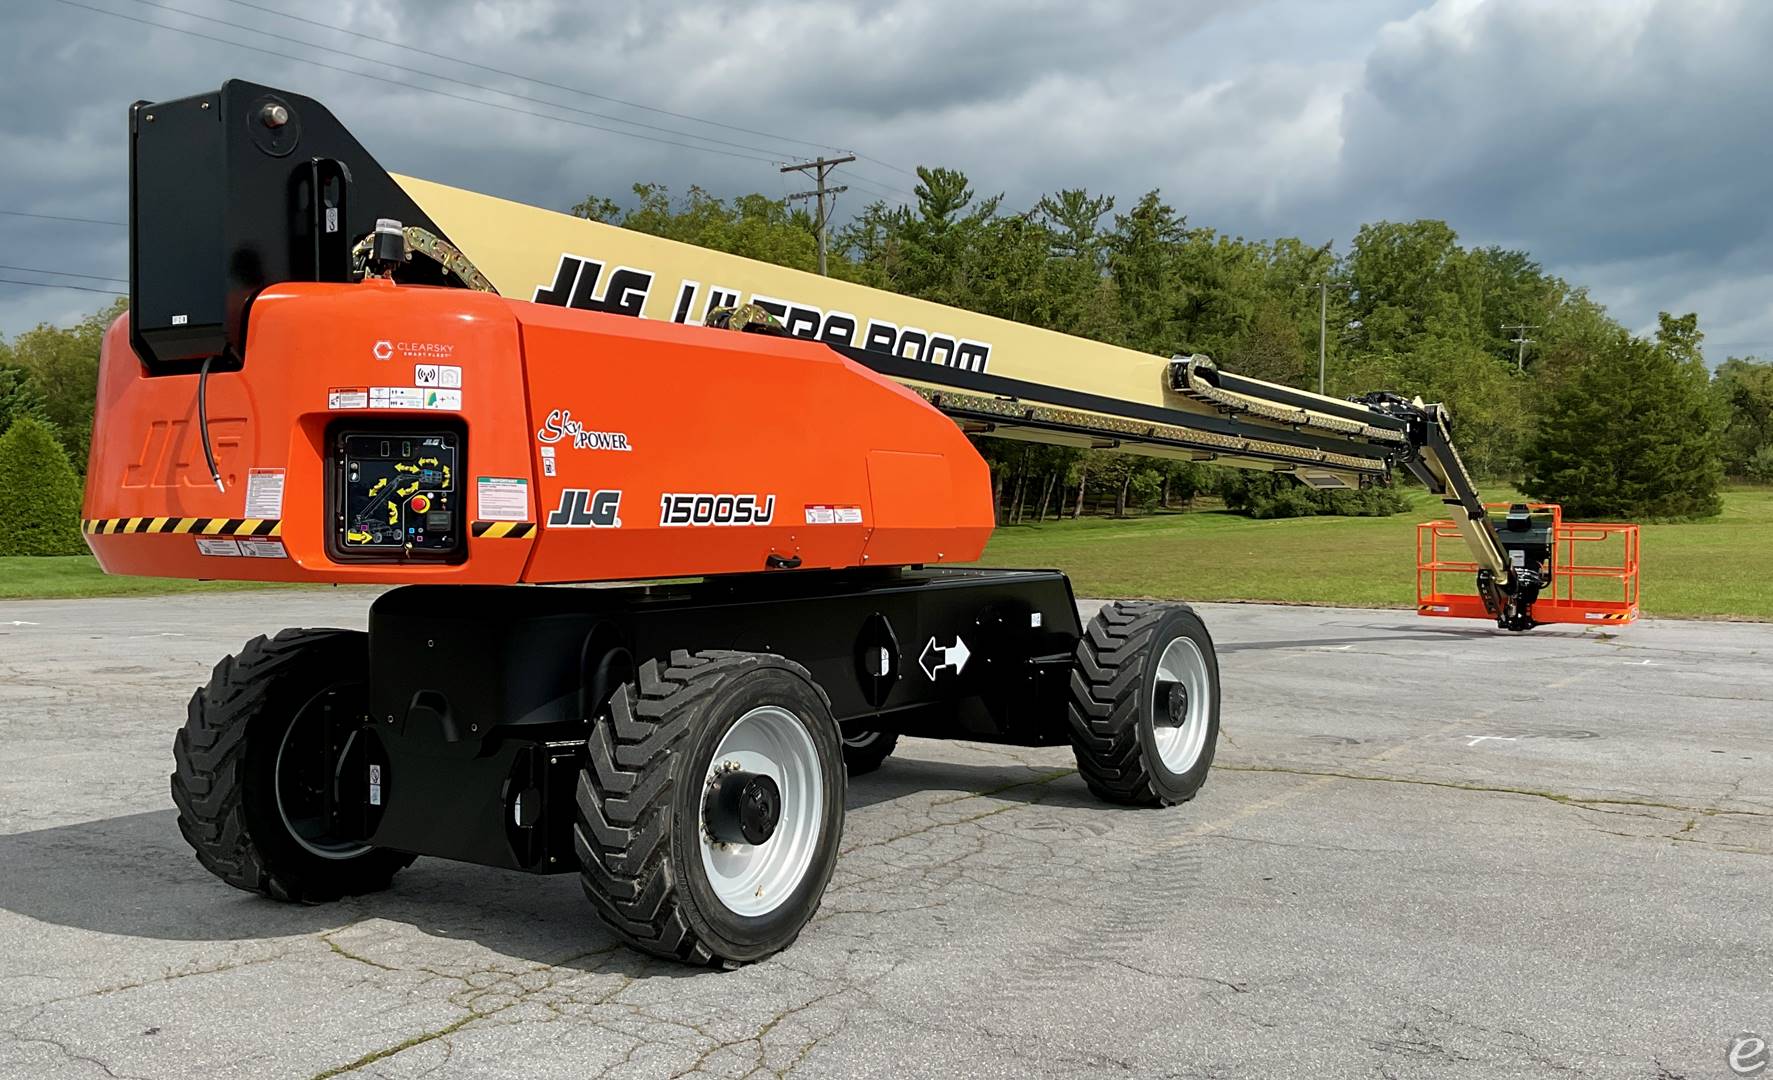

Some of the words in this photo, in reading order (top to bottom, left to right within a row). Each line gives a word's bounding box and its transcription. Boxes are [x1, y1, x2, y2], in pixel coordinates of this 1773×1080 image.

[534, 253, 655, 319] JLG
[397, 342, 454, 352] CLEARSKY
[547, 489, 621, 527] JLG
[660, 494, 776, 527] 1500SJ
